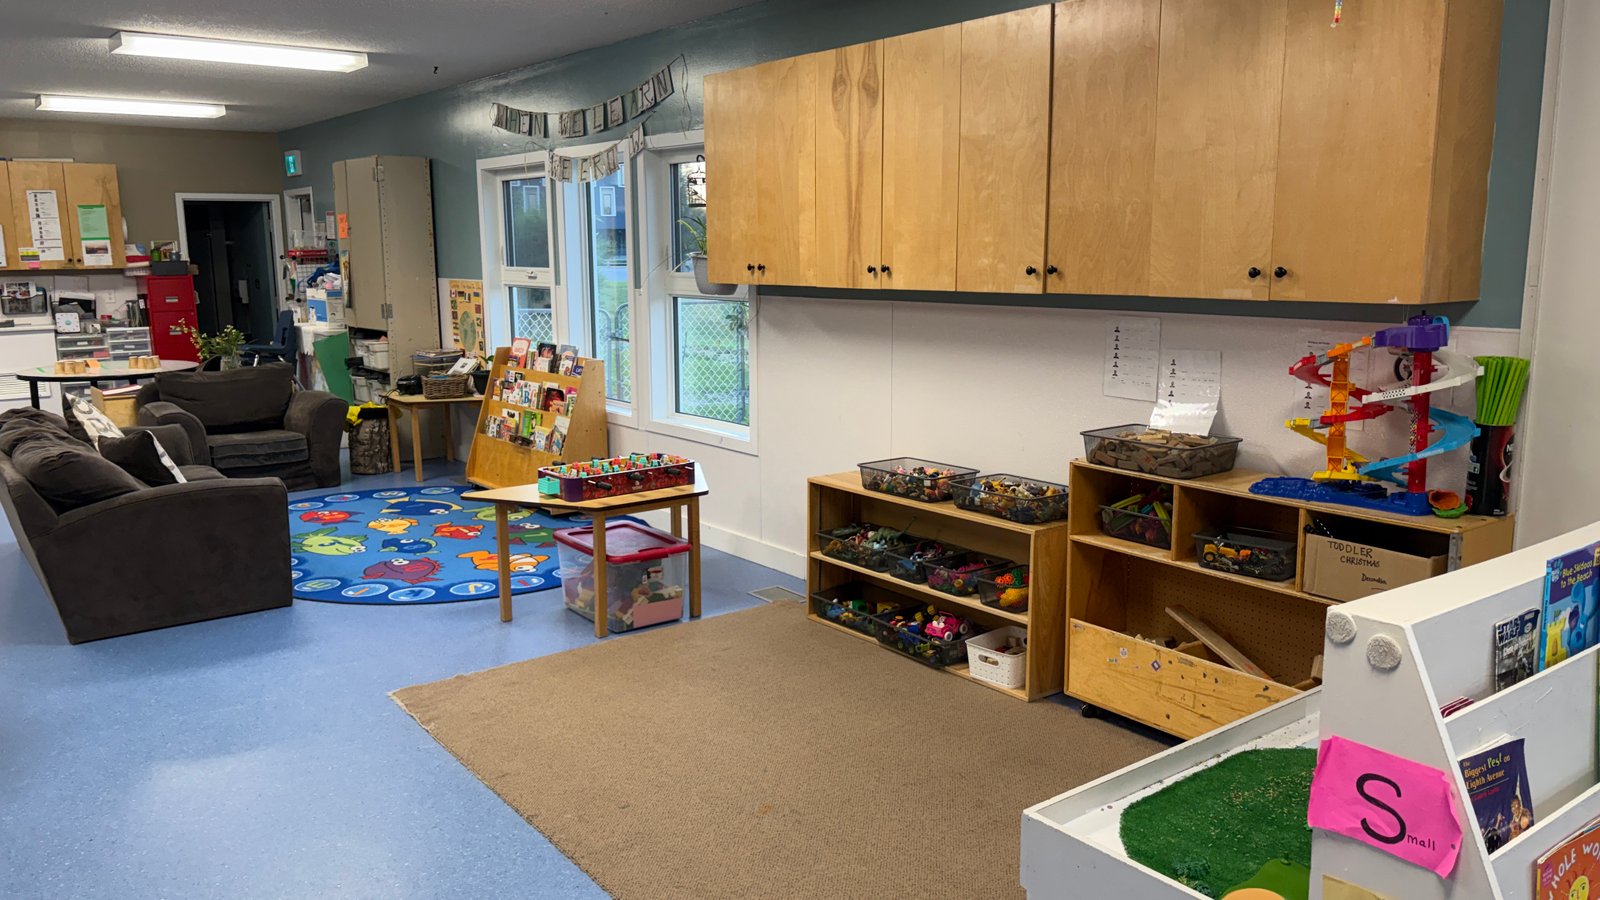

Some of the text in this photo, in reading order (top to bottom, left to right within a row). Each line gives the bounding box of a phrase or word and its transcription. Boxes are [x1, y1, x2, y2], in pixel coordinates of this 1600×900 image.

[560, 112, 582, 134] WE
[593, 69, 669, 130] LEARN
[550, 153, 572, 181] WE
[1327, 540, 1373, 559] TODDLER
[1340, 556, 1380, 568] CHRISTMAS
[1498, 617, 1520, 635] STAR
[1498, 626, 1519, 645] WARS
[1464, 763, 1487, 778] Biggest
[1487, 751, 1502, 768] Pest
[1466, 769, 1505, 790] Eighth Avenue
